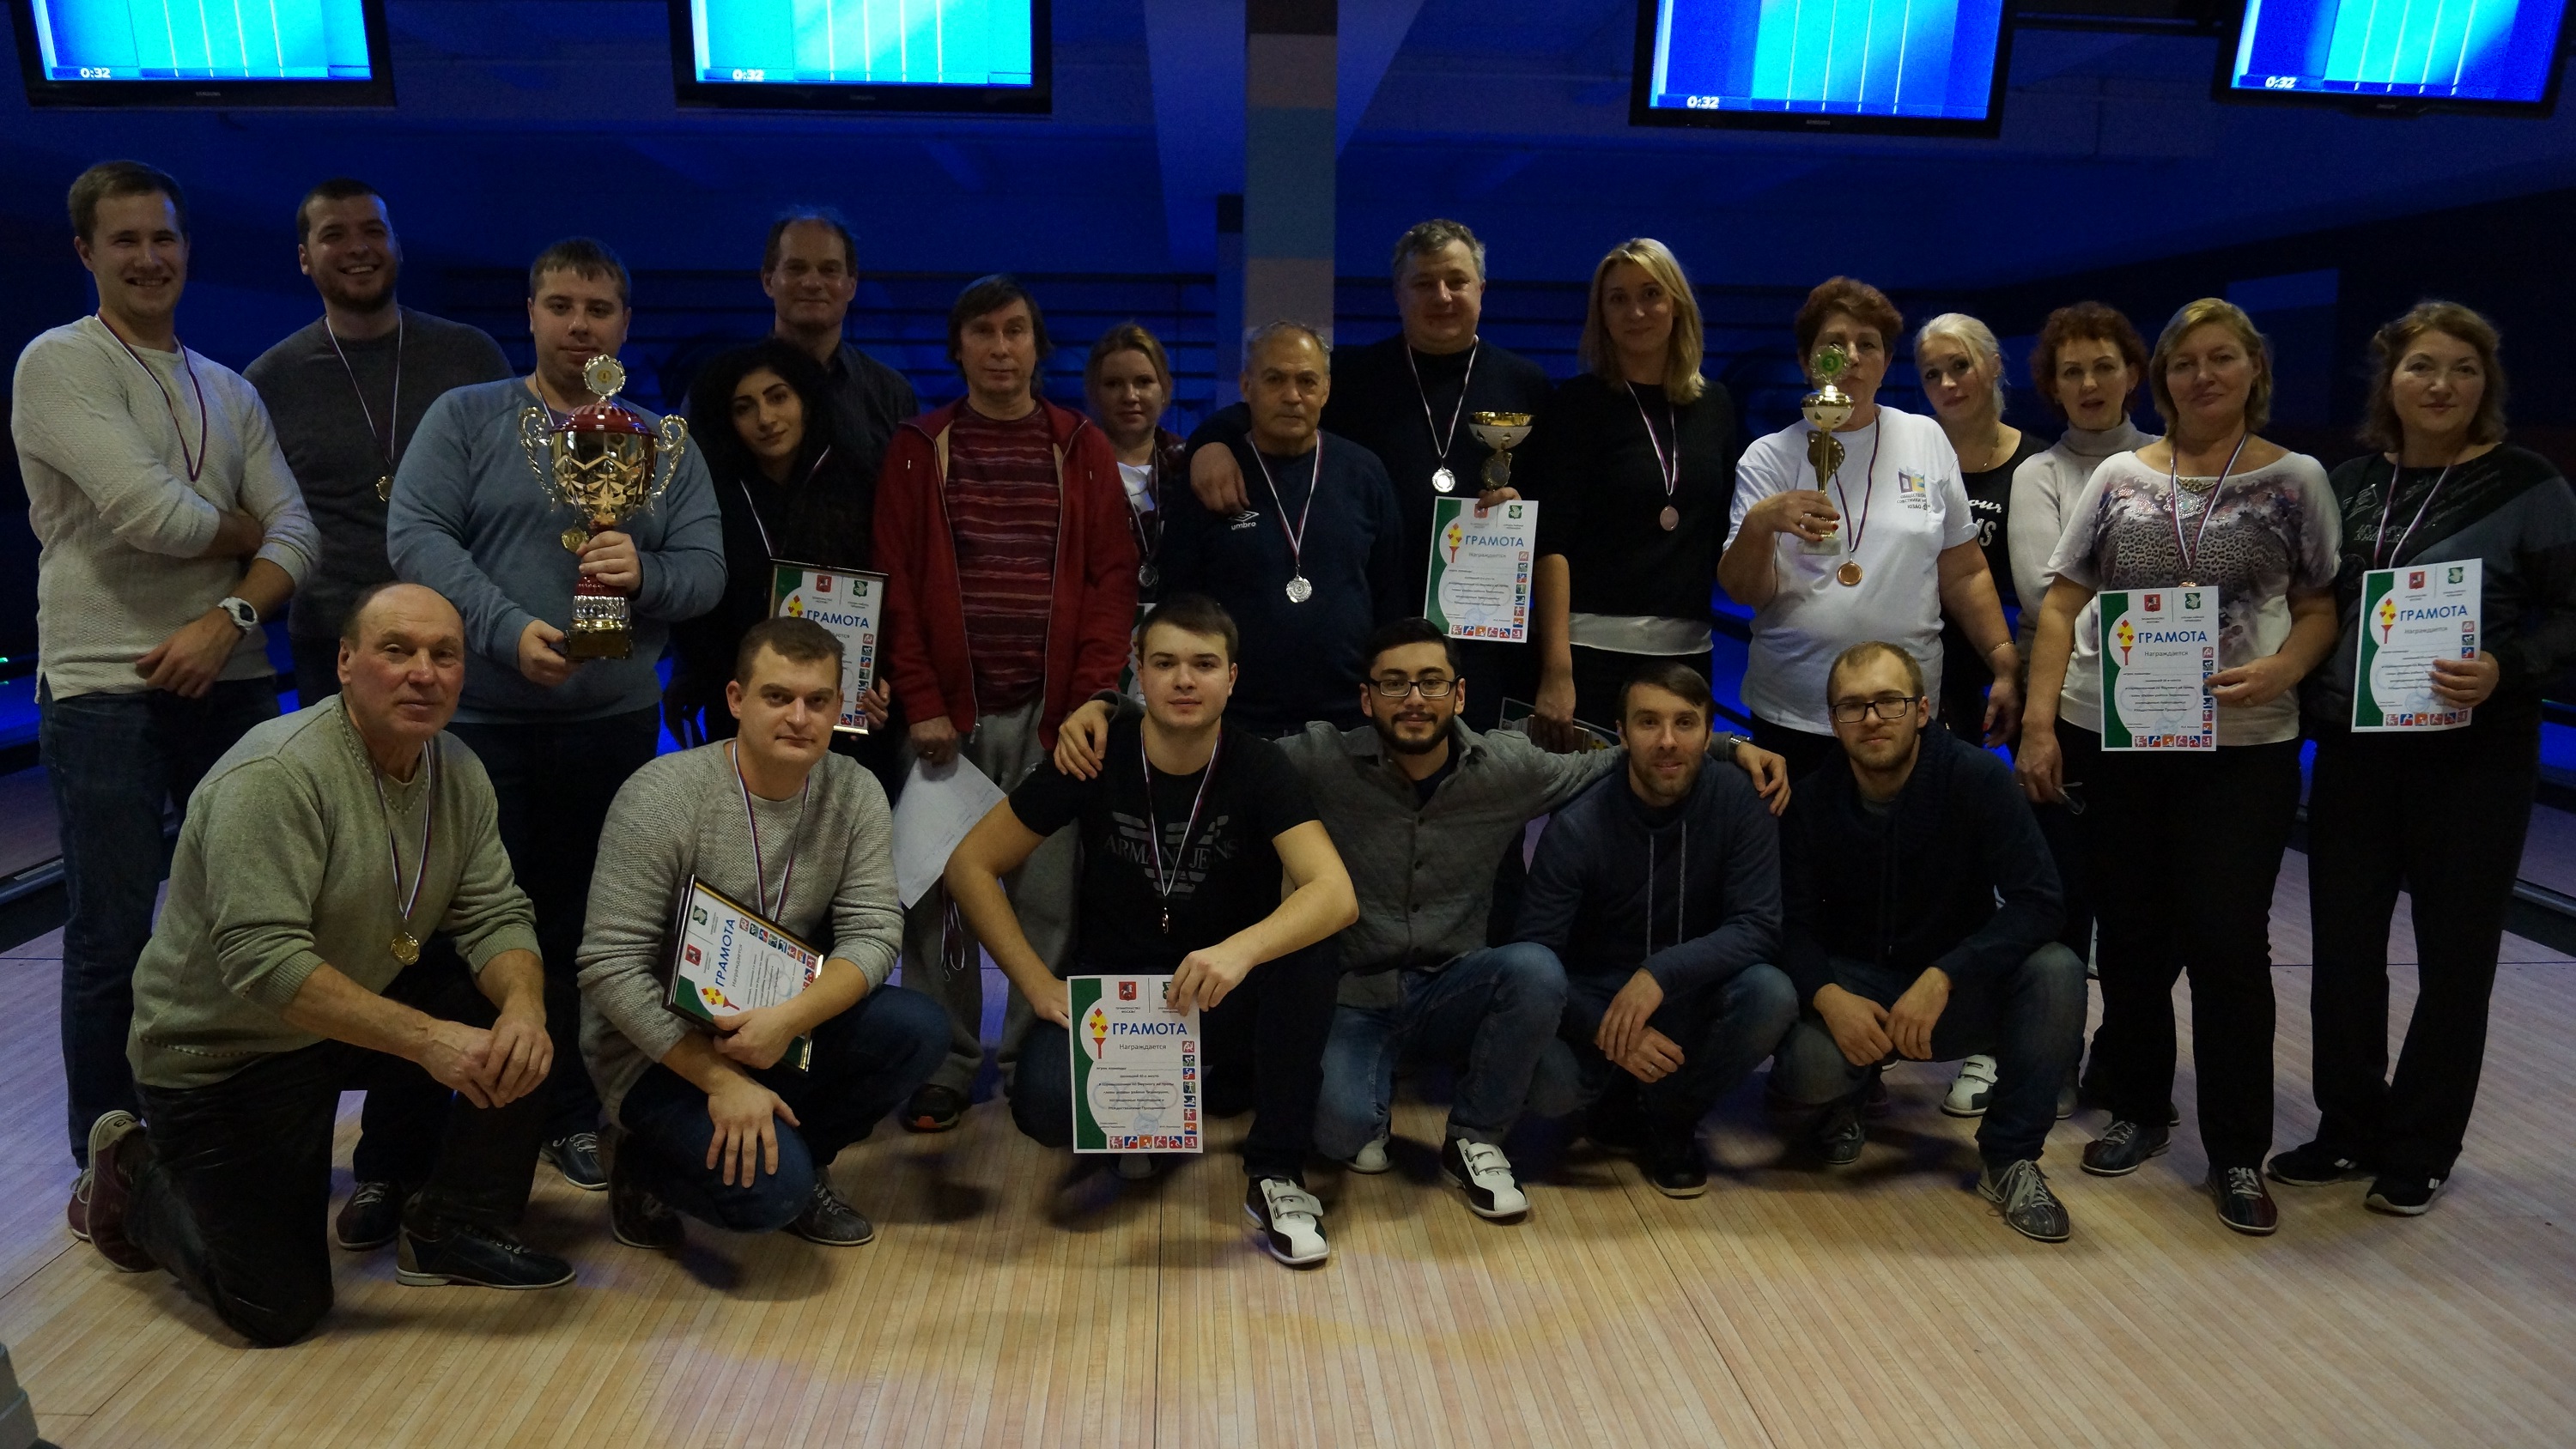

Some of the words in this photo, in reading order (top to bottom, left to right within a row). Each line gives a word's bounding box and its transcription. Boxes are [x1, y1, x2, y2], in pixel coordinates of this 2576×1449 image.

[80, 67, 112, 79] 0:32
[732, 69, 765, 82] 0:32
[2264, 76, 2298, 89] 0:32
[1686, 95, 1720, 109] 0:32
[1230, 520, 1256, 530] umbro
[1465, 535, 1524, 547] ГРАМОТА
[806, 609, 870, 628] ГРАМОТА
[2400, 604, 2468, 621] ГРАМОТА
[2138, 631, 2208, 644] ГРАМОТА
[715, 919, 736, 987] ГРАМОТА
[1112, 1022, 1188, 1035] ГРАМОТА
